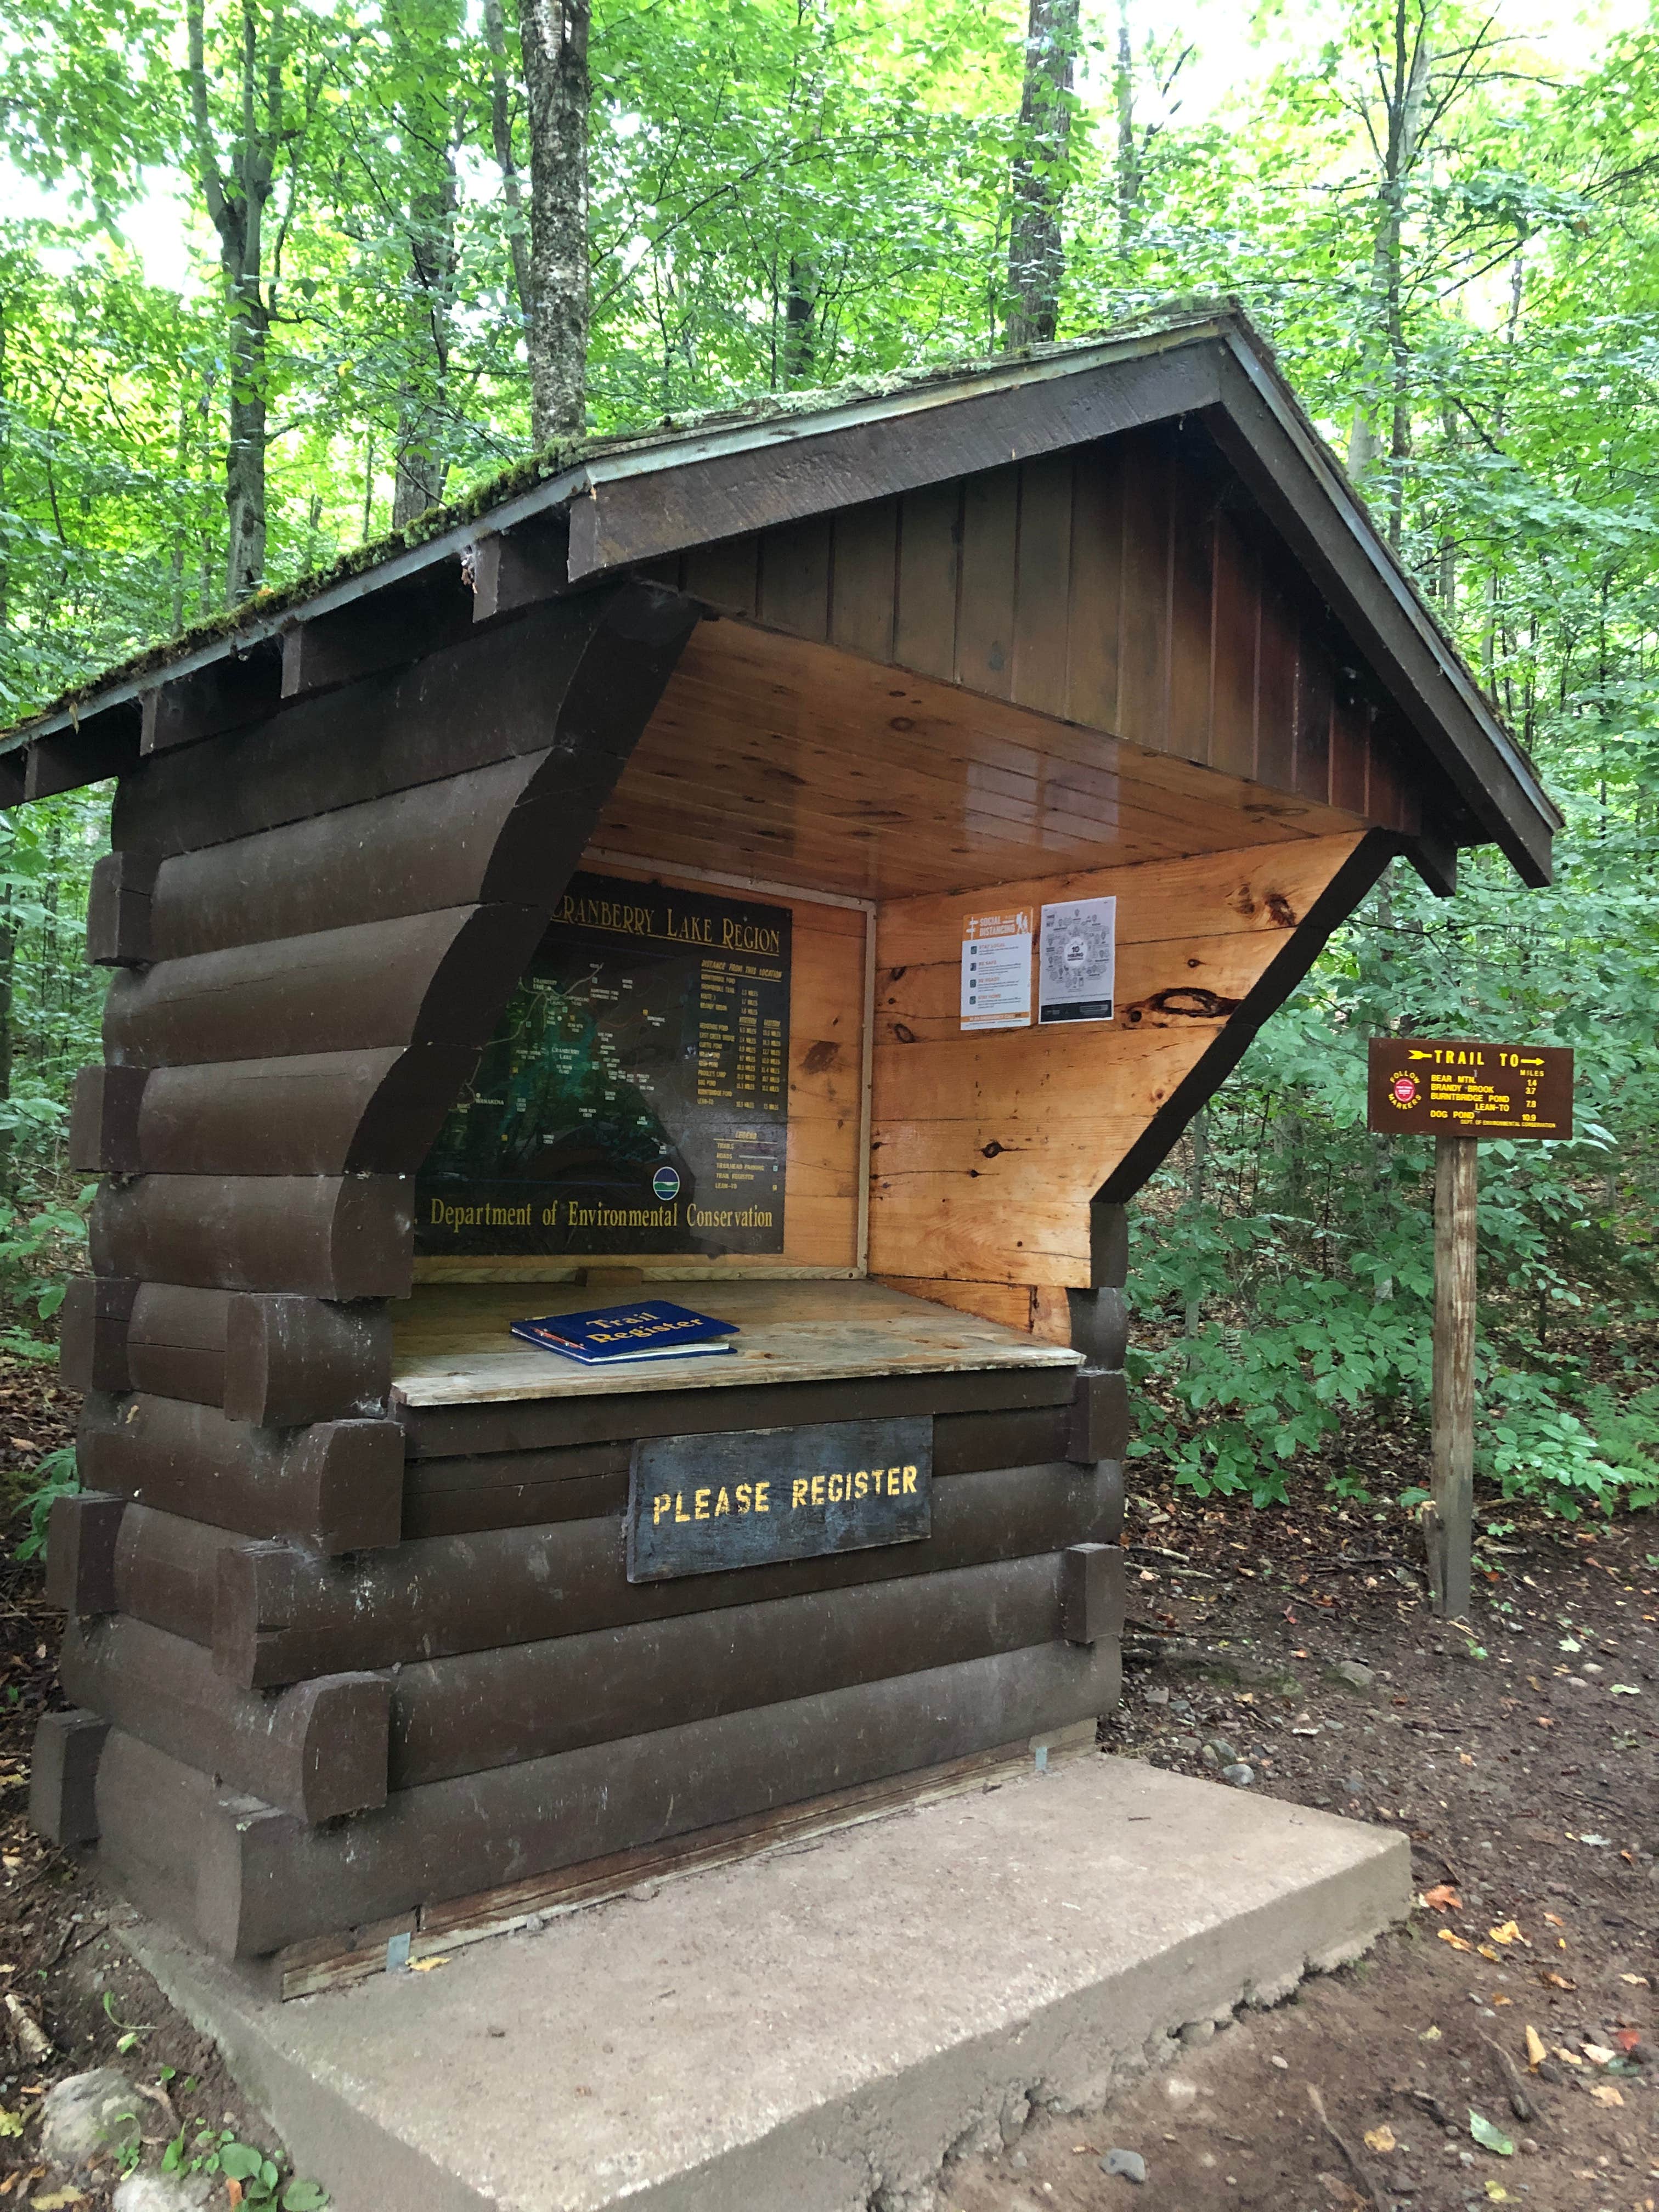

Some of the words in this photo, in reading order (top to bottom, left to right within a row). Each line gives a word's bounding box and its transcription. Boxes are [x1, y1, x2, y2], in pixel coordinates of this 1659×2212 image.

[980, 917, 1001, 927] SOCIAL
[667, 909, 712, 943] LAKE
[723, 918, 780, 952] REGION
[1435, 1049, 1485, 1065] TRAIL
[1500, 1053, 1519, 1068] TO
[1389, 1070, 1421, 1084] FOLLOW
[1431, 1074, 1452, 1082] BEAR
[1431, 1084, 1462, 1092] BRANDY
[1468, 1085, 1494, 1093] BROOK
[1387, 1093, 1422, 1110] MARKERS
[1431, 1093, 1483, 1102] BURNTBRIDGE
[1430, 1110, 1448, 1119] DOG
[1453, 1111, 1475, 1119] POND
[1475, 1103, 1509, 1111] LEAN-TO
[430, 1198, 532, 1233] Department
[542, 1200, 557, 1226] of
[568, 1201, 678, 1227] Environmental
[686, 1203, 773, 1228] Conservation
[586, 1311, 660, 1329] Trail
[585, 1317, 704, 1344] Register
[653, 1481, 770, 1525] PLEASE
[792, 1465, 918, 1509] REGISTER
